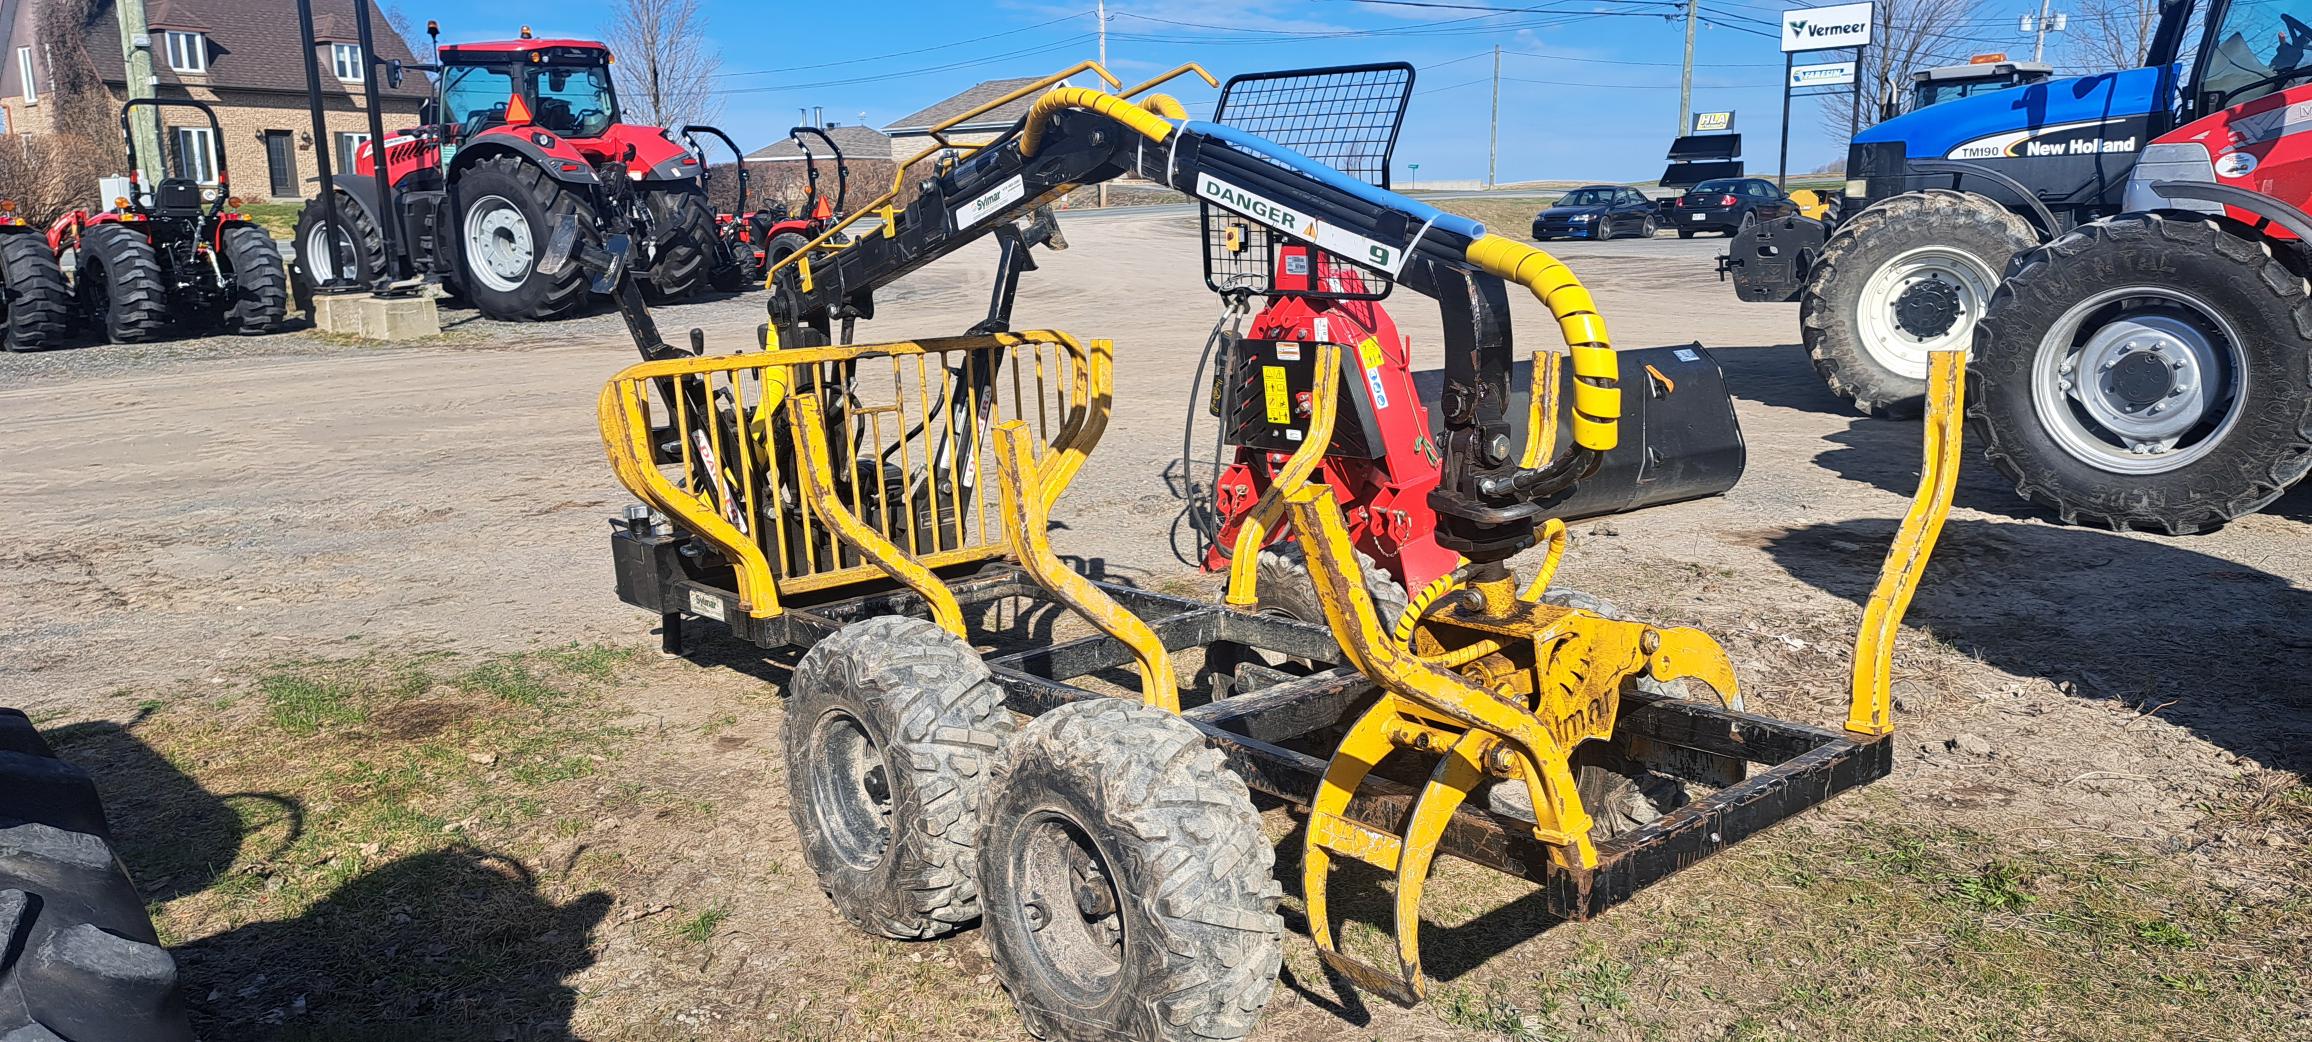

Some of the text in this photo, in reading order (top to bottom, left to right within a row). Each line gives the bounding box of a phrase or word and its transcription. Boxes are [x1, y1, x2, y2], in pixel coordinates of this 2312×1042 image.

[1808, 23, 1866, 37] Vermeer
[1701, 114, 1726, 125] HLA
[1962, 146, 1999, 158] TM190
[2027, 137, 2135, 156] New Holland
[976, 191, 1001, 211] Sylmar
[1206, 180, 1296, 229] DANGER
[1368, 245, 1390, 267] 9
